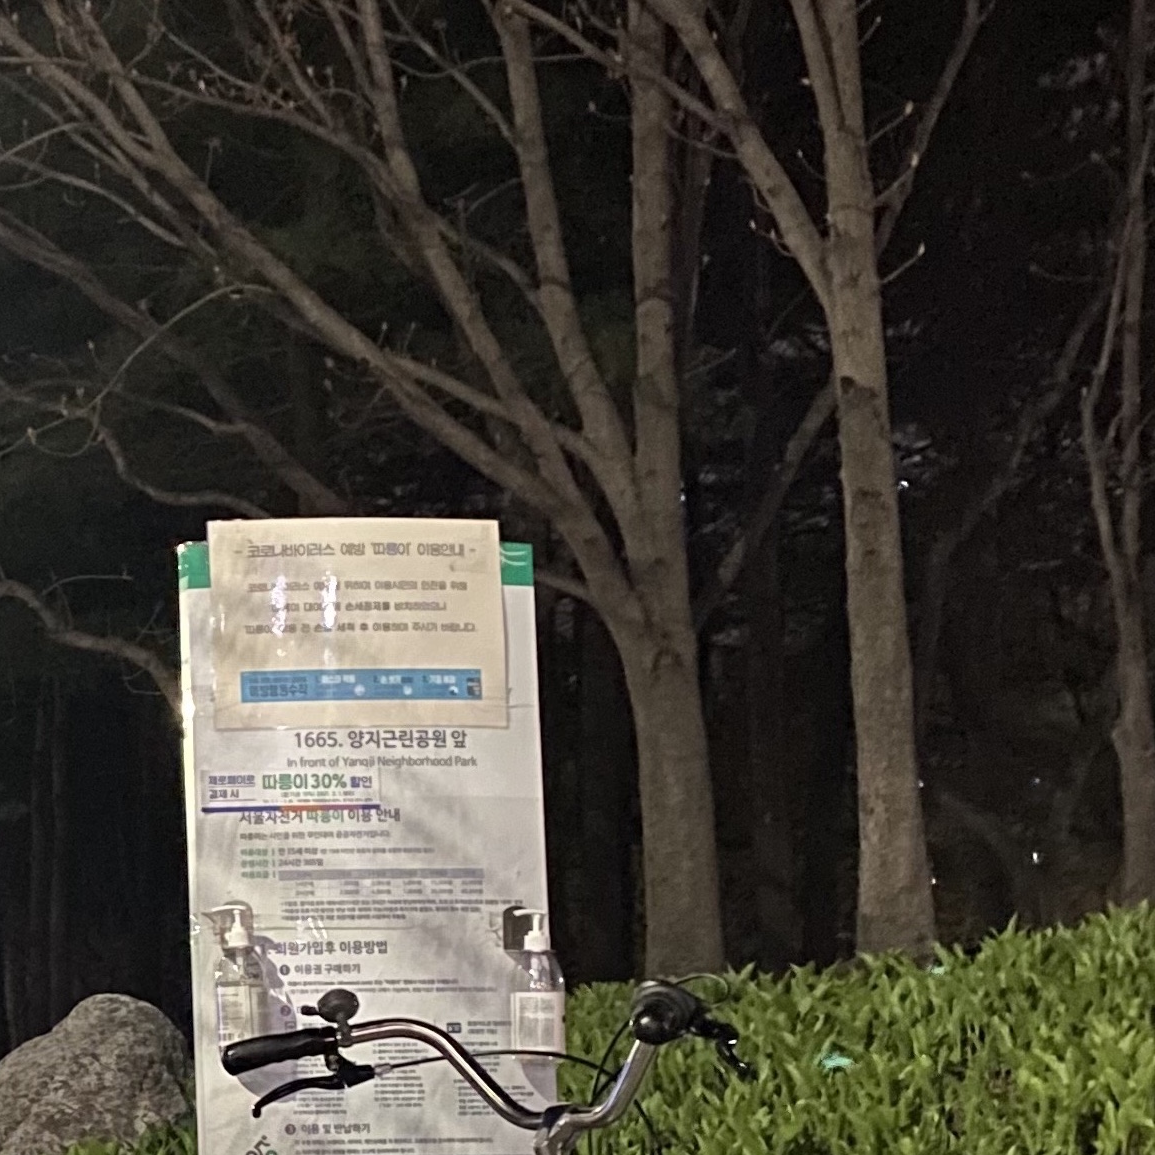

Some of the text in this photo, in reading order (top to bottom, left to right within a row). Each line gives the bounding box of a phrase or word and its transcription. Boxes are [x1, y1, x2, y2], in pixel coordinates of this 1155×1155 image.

[340, 543, 365, 557] 예방
[294, 730, 467, 749] 1665. 양지근린공원 앞
[299, 755, 326, 767] front
[329, 755, 340, 767] of
[377, 754, 453, 769] Neighborhood
[455, 754, 478, 767] Park
[262, 773, 308, 790] 따릉이
[311, 773, 347, 789] 30%
[306, 811, 344, 824] 따릉이
[347, 809, 373, 823] 이용
[376, 808, 401, 822] 안내
[339, 939, 388, 955] 이용방법
